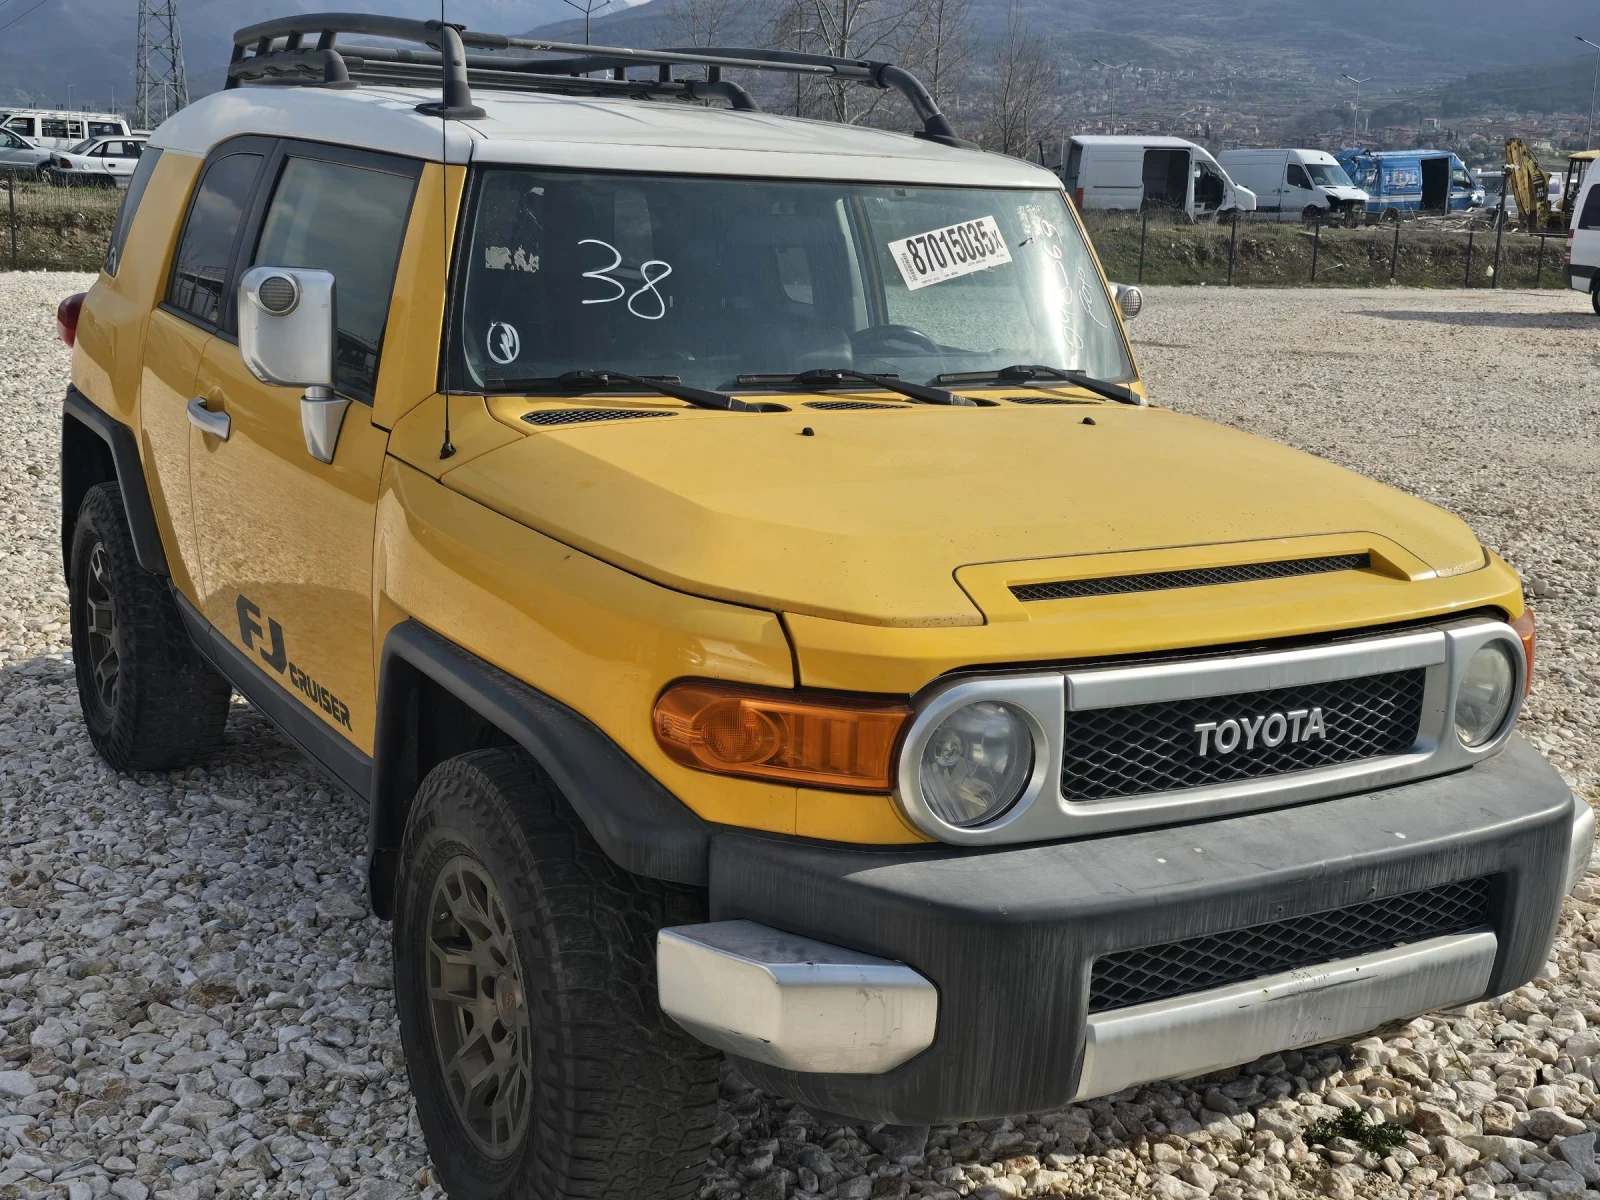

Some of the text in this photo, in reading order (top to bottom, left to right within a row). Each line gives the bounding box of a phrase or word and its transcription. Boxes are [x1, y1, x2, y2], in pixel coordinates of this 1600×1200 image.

[577, 238, 673, 320] 38
[236, 593, 353, 733] FJ CRUISER
[1194, 707, 1327, 756] TOYOTA
